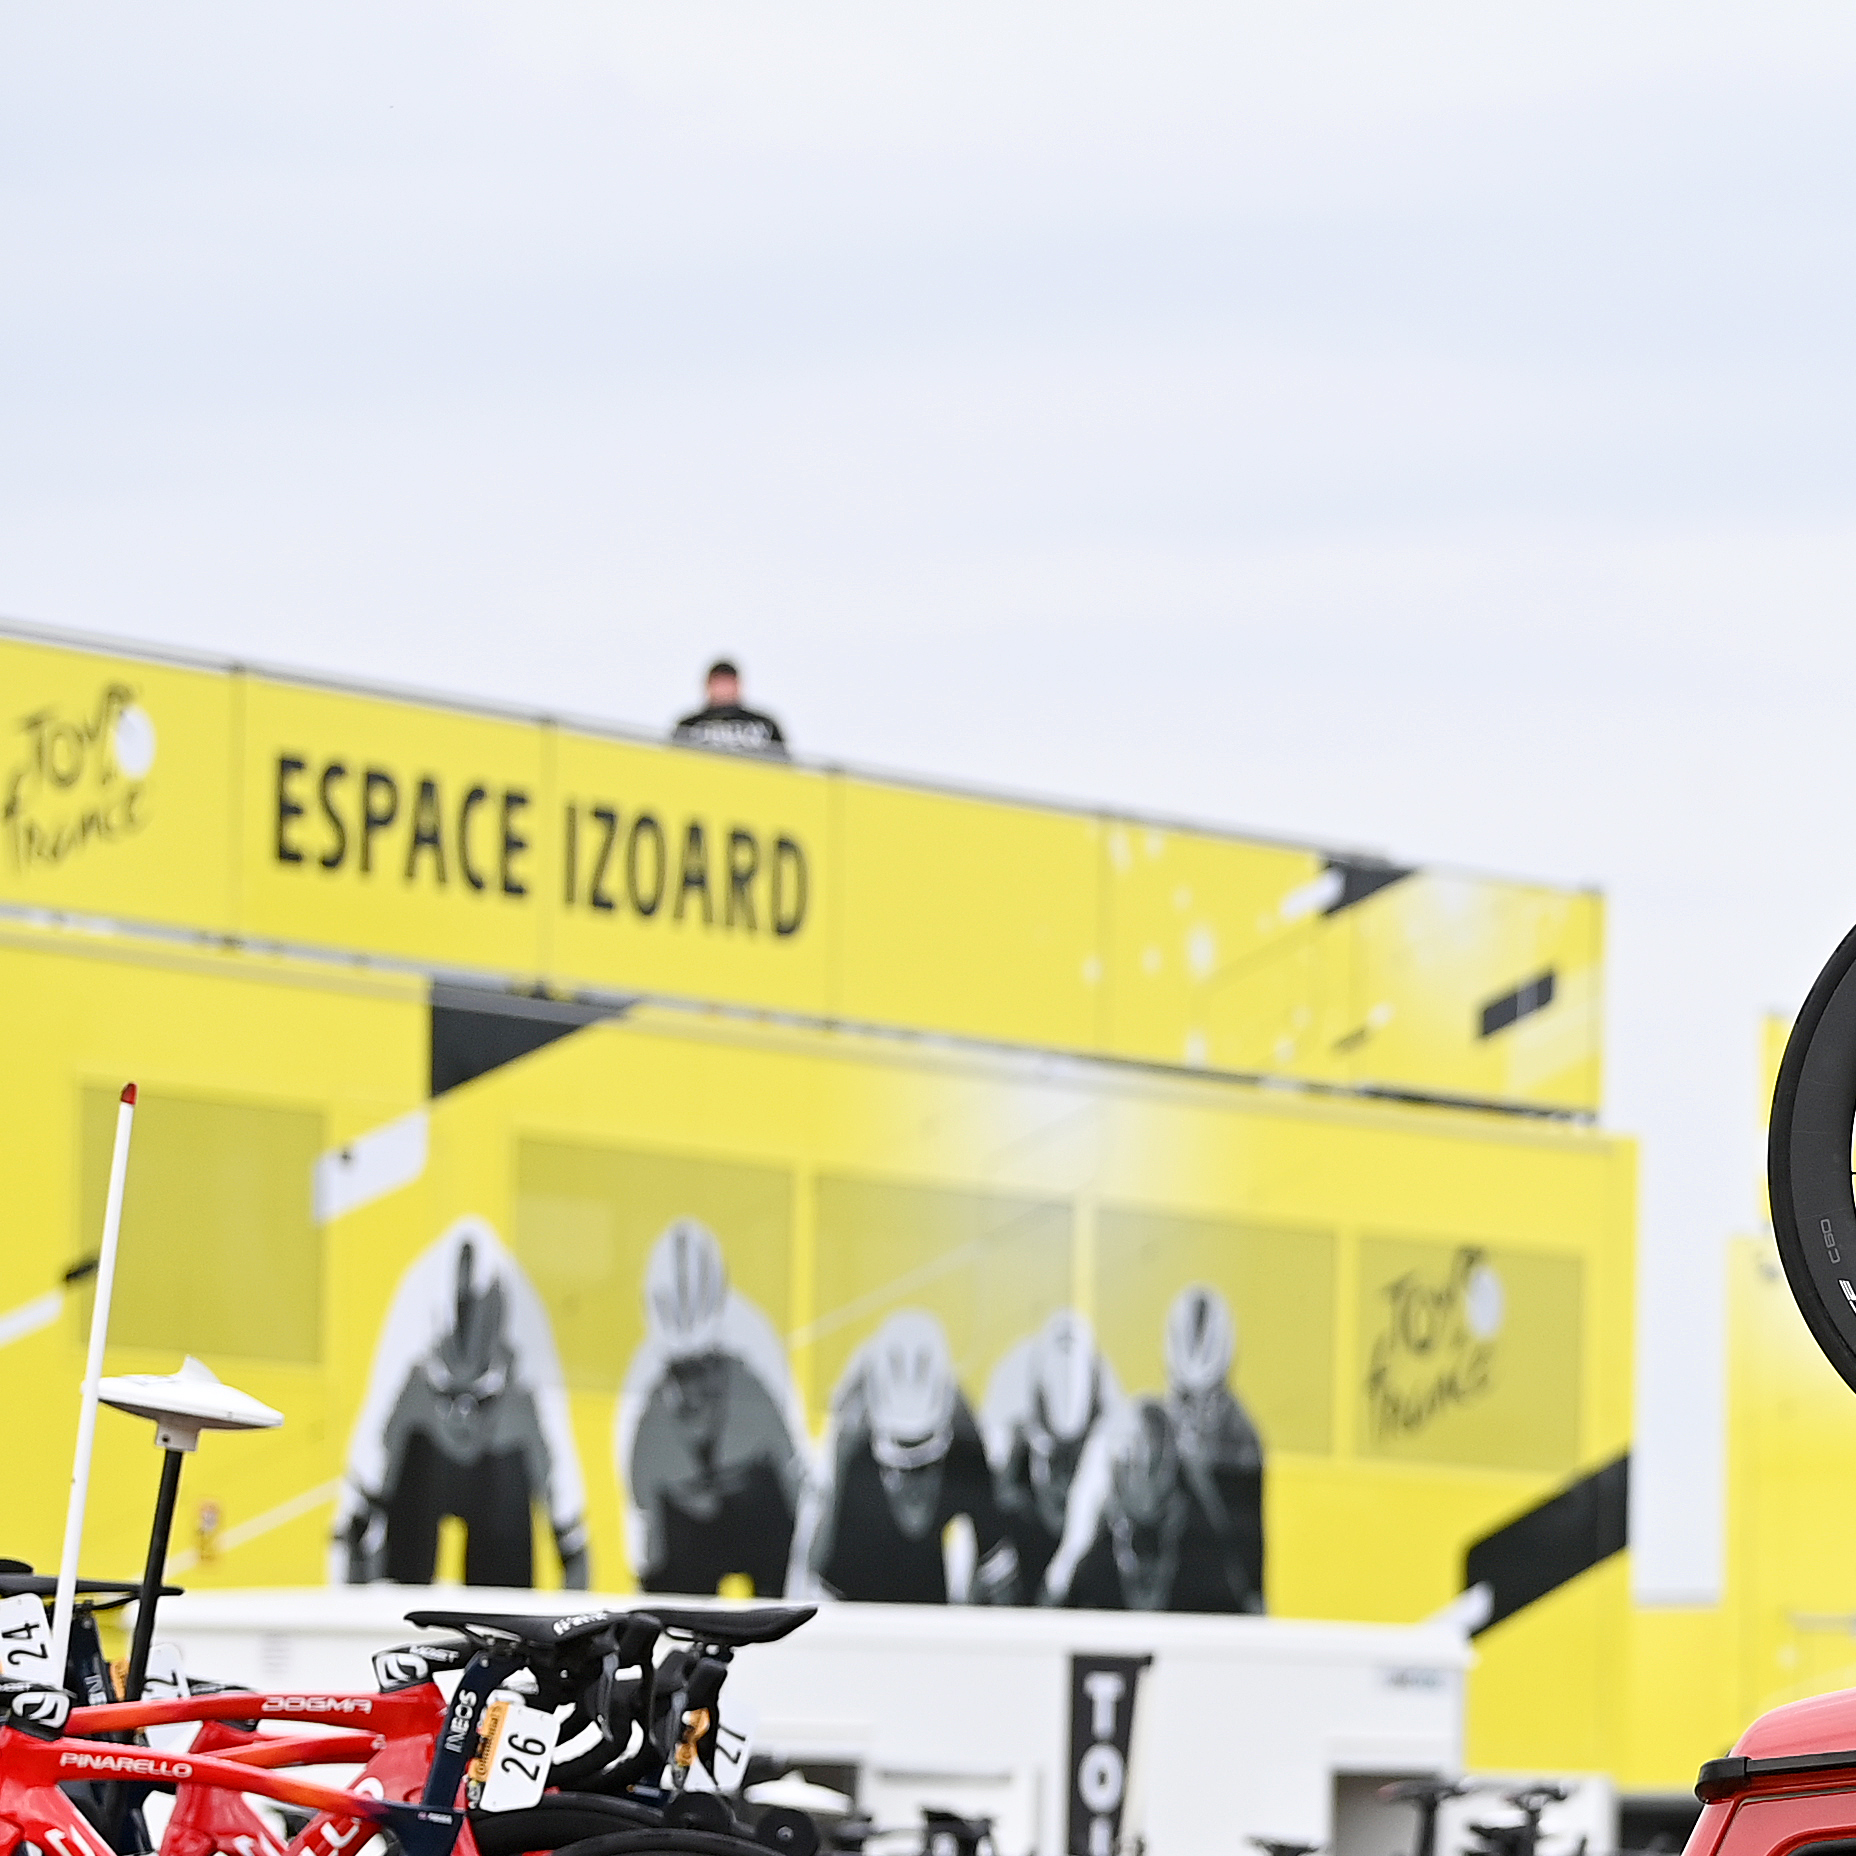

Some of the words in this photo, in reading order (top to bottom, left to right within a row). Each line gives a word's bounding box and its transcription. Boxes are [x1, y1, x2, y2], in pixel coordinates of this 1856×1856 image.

[274, 754, 530, 898] ESPACE
[565, 803, 812, 940] IZOARD
[1819, 1218, 1841, 1265] C60
[2, 1621, 48, 1667] 24
[261, 1696, 373, 1716] DOGMA
[444, 1689, 478, 1754] INEOS
[59, 1752, 194, 1779] PINARELLO
[501, 1733, 546, 1781] 26
